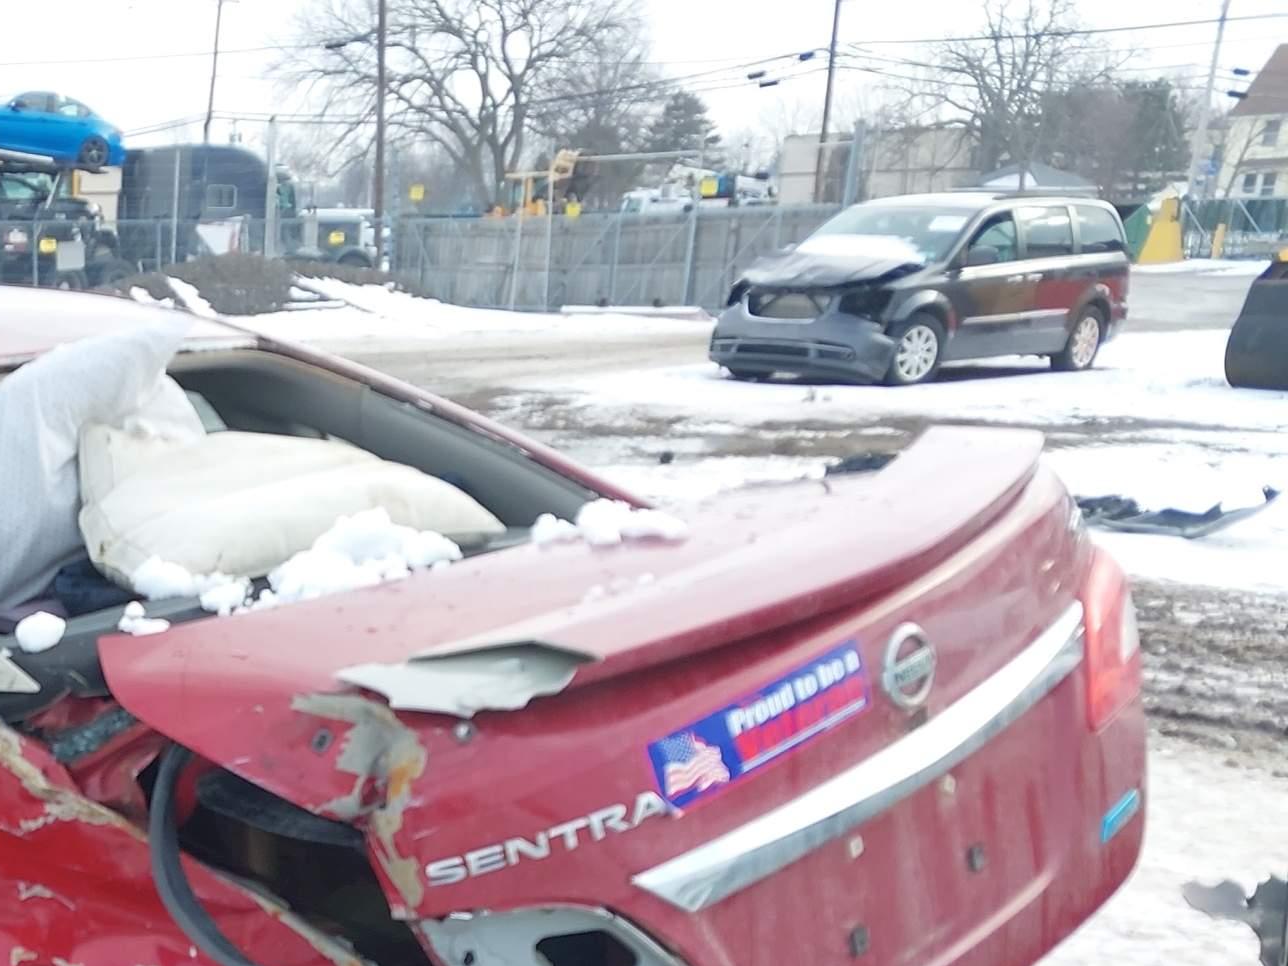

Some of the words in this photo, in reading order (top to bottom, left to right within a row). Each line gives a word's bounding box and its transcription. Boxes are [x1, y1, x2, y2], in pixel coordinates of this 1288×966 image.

[726, 682, 795, 738] Proud
[792, 673, 818, 702] to
[817, 658, 845, 689] be
[844, 649, 861, 673] a
[425, 790, 676, 886] SENTRA
